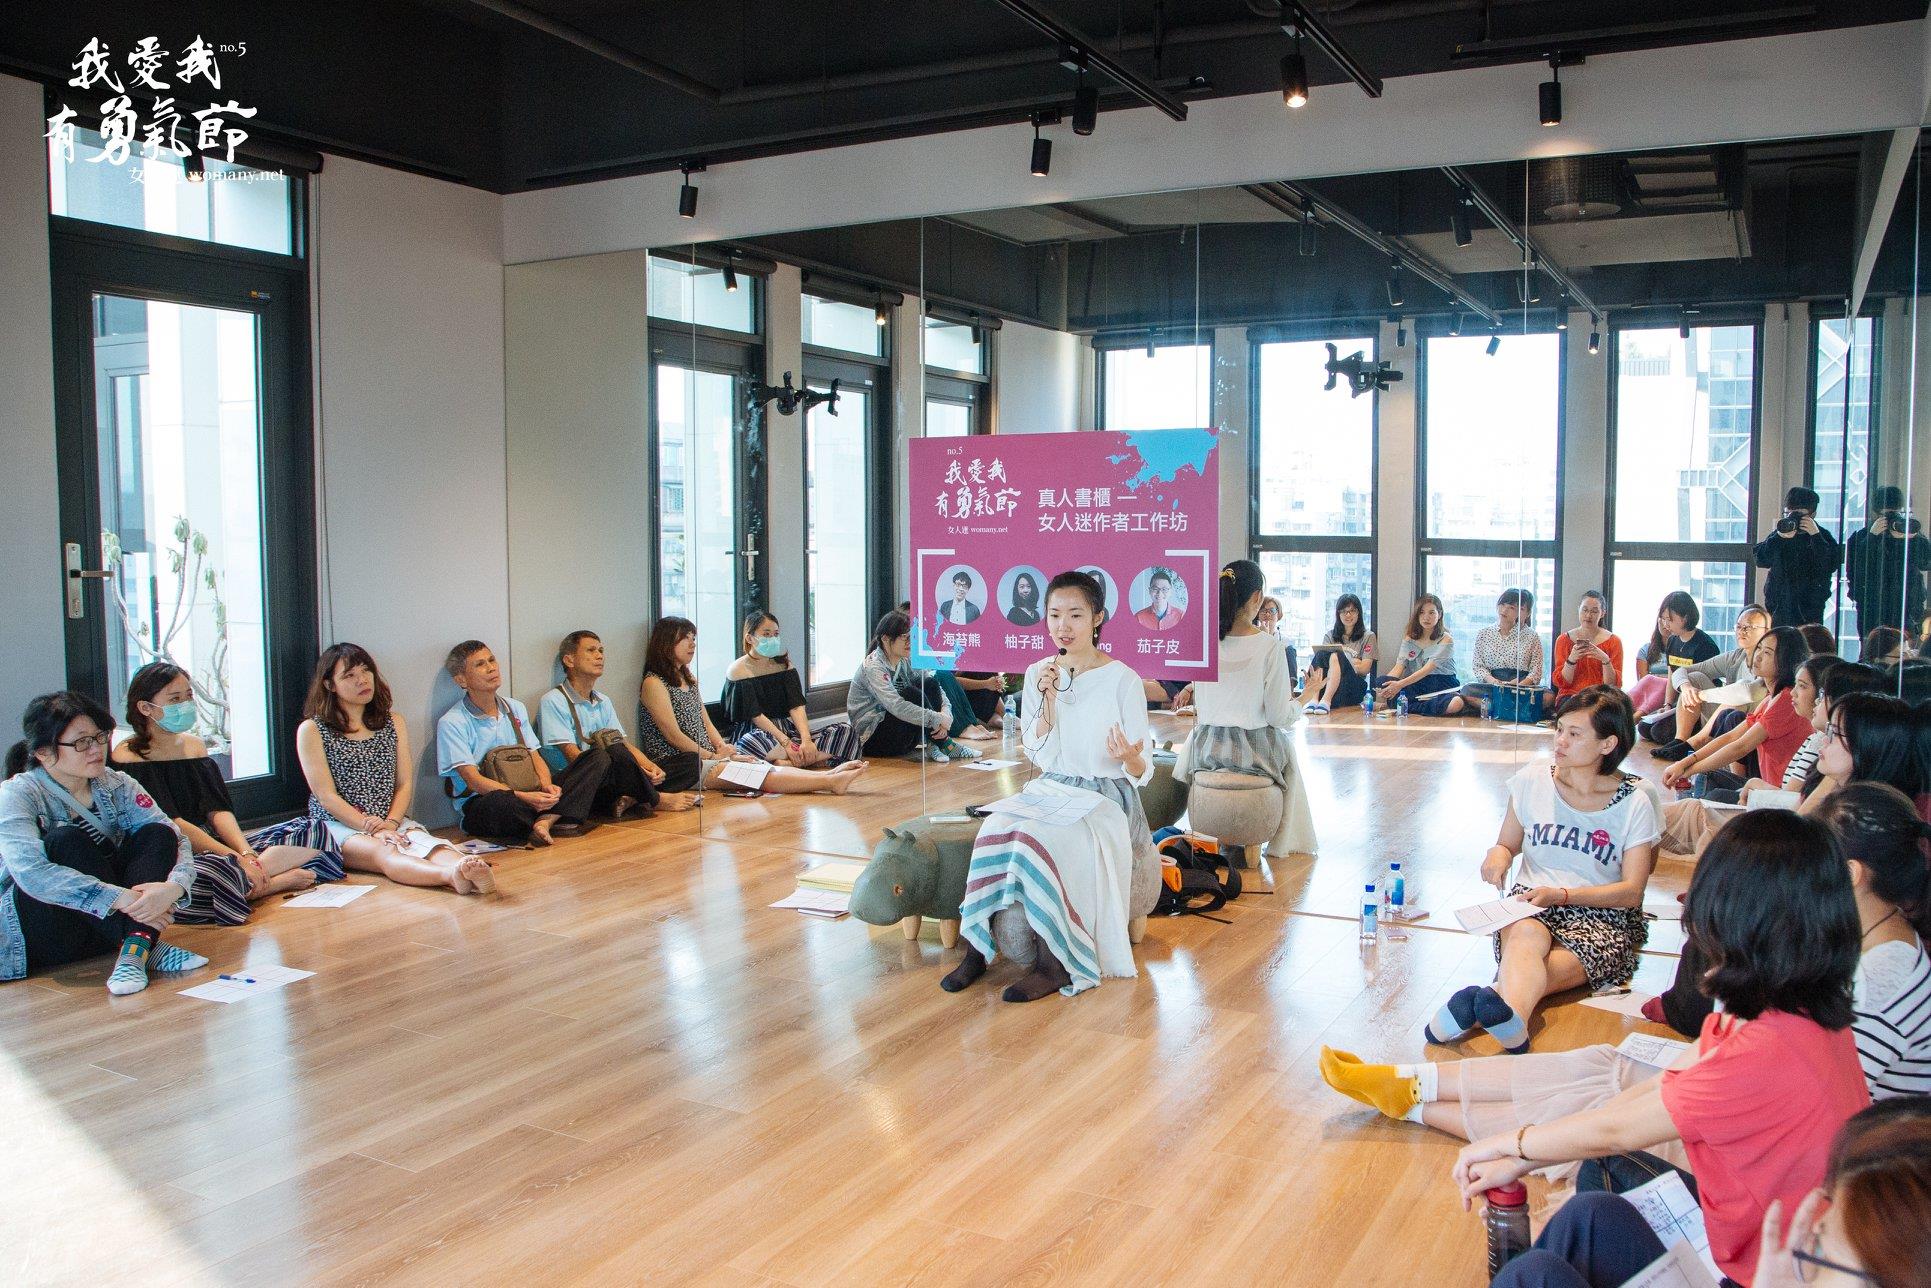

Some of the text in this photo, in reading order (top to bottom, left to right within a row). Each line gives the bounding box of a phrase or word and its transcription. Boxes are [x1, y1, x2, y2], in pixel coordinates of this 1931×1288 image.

[947, 446, 963, 455] no.5
[944, 457, 1007, 486] 我愛我
[934, 486, 1022, 519] 有勇氣節
[1038, 487, 1111, 508] 真人書櫃
[970, 526, 1008, 534] womany.net
[1038, 511, 1188, 533] 女人迷作者工作坊
[942, 632, 981, 648] 海苔熊
[1004, 634, 1045, 650] 柚子甜
[1136, 638, 1180, 655] 茄子皮
